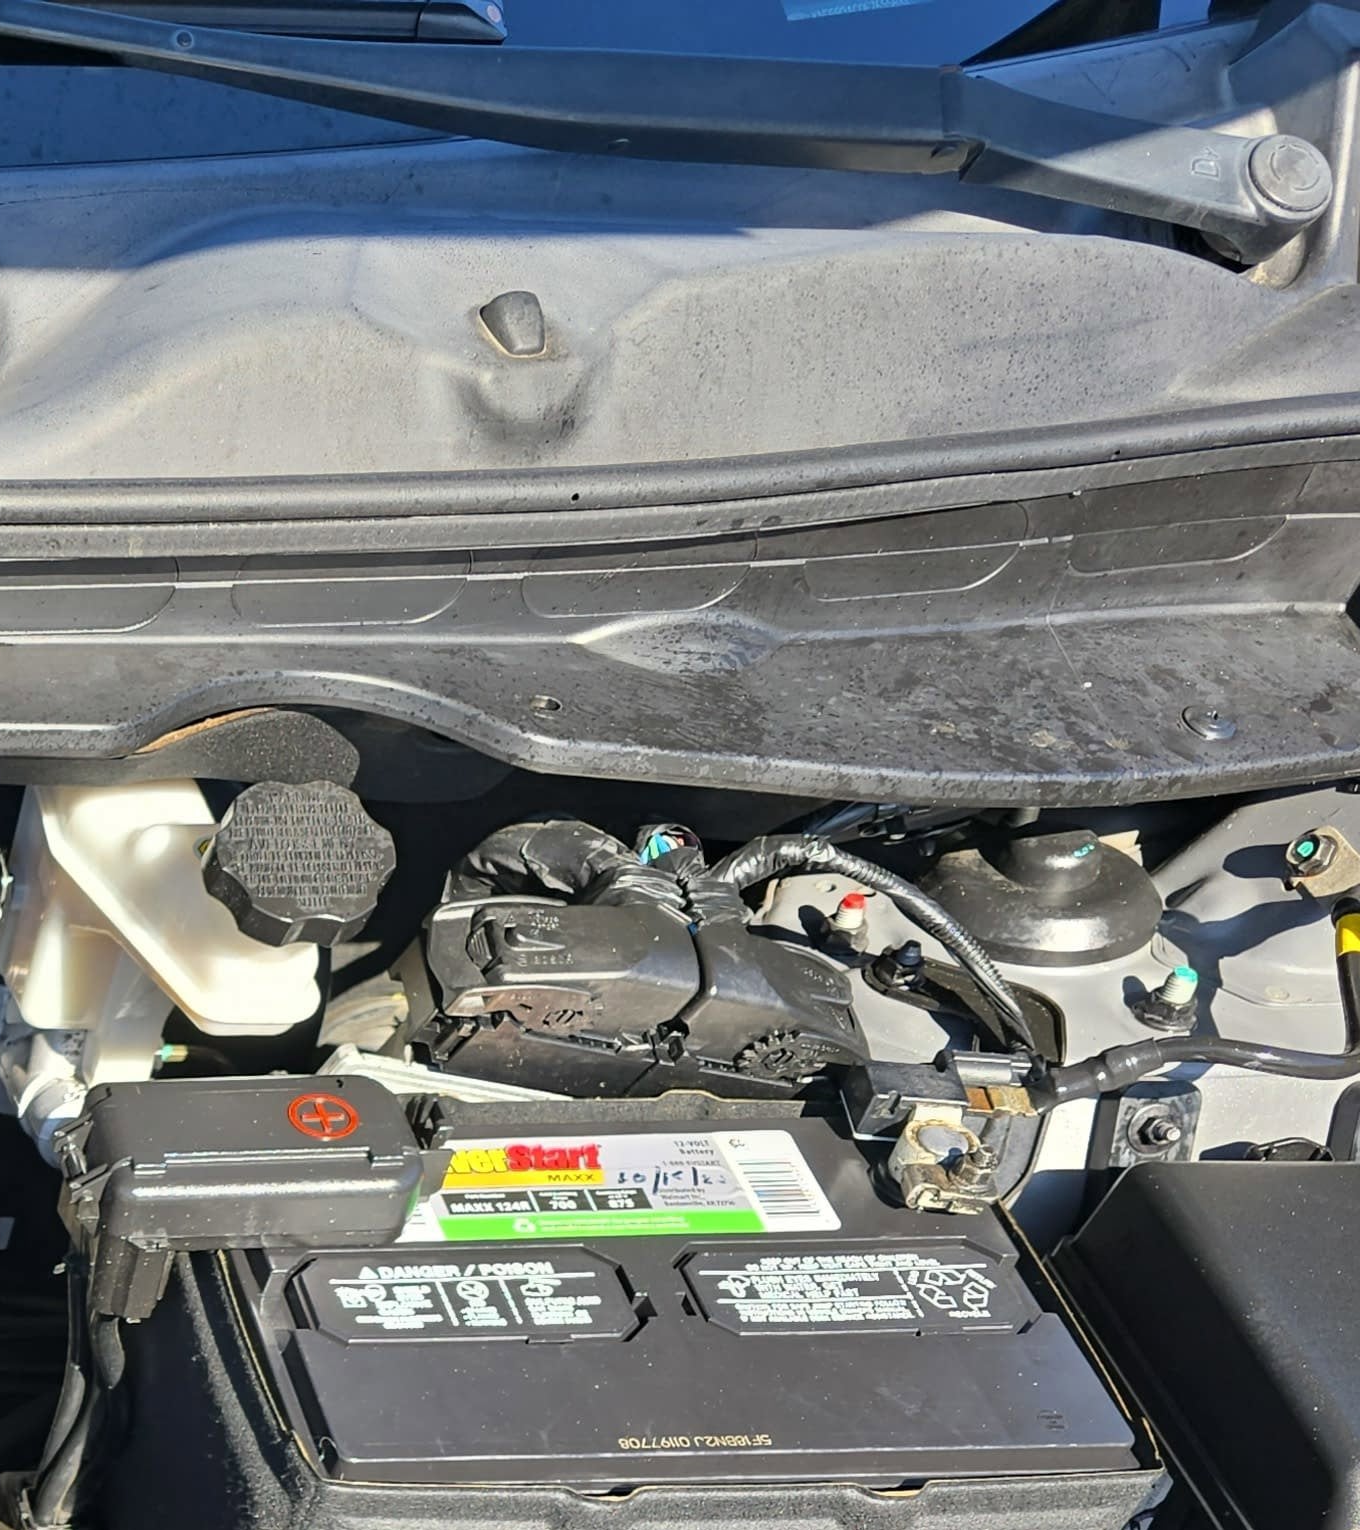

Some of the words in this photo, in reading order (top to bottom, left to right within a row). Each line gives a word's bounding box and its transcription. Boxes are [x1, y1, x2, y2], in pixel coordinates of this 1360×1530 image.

[546, 1173, 595, 1182] MAXX
[450, 1202, 496, 1214] MAXX
[377, 1264, 462, 1279] DANGER
[479, 1261, 555, 1277] POISON
